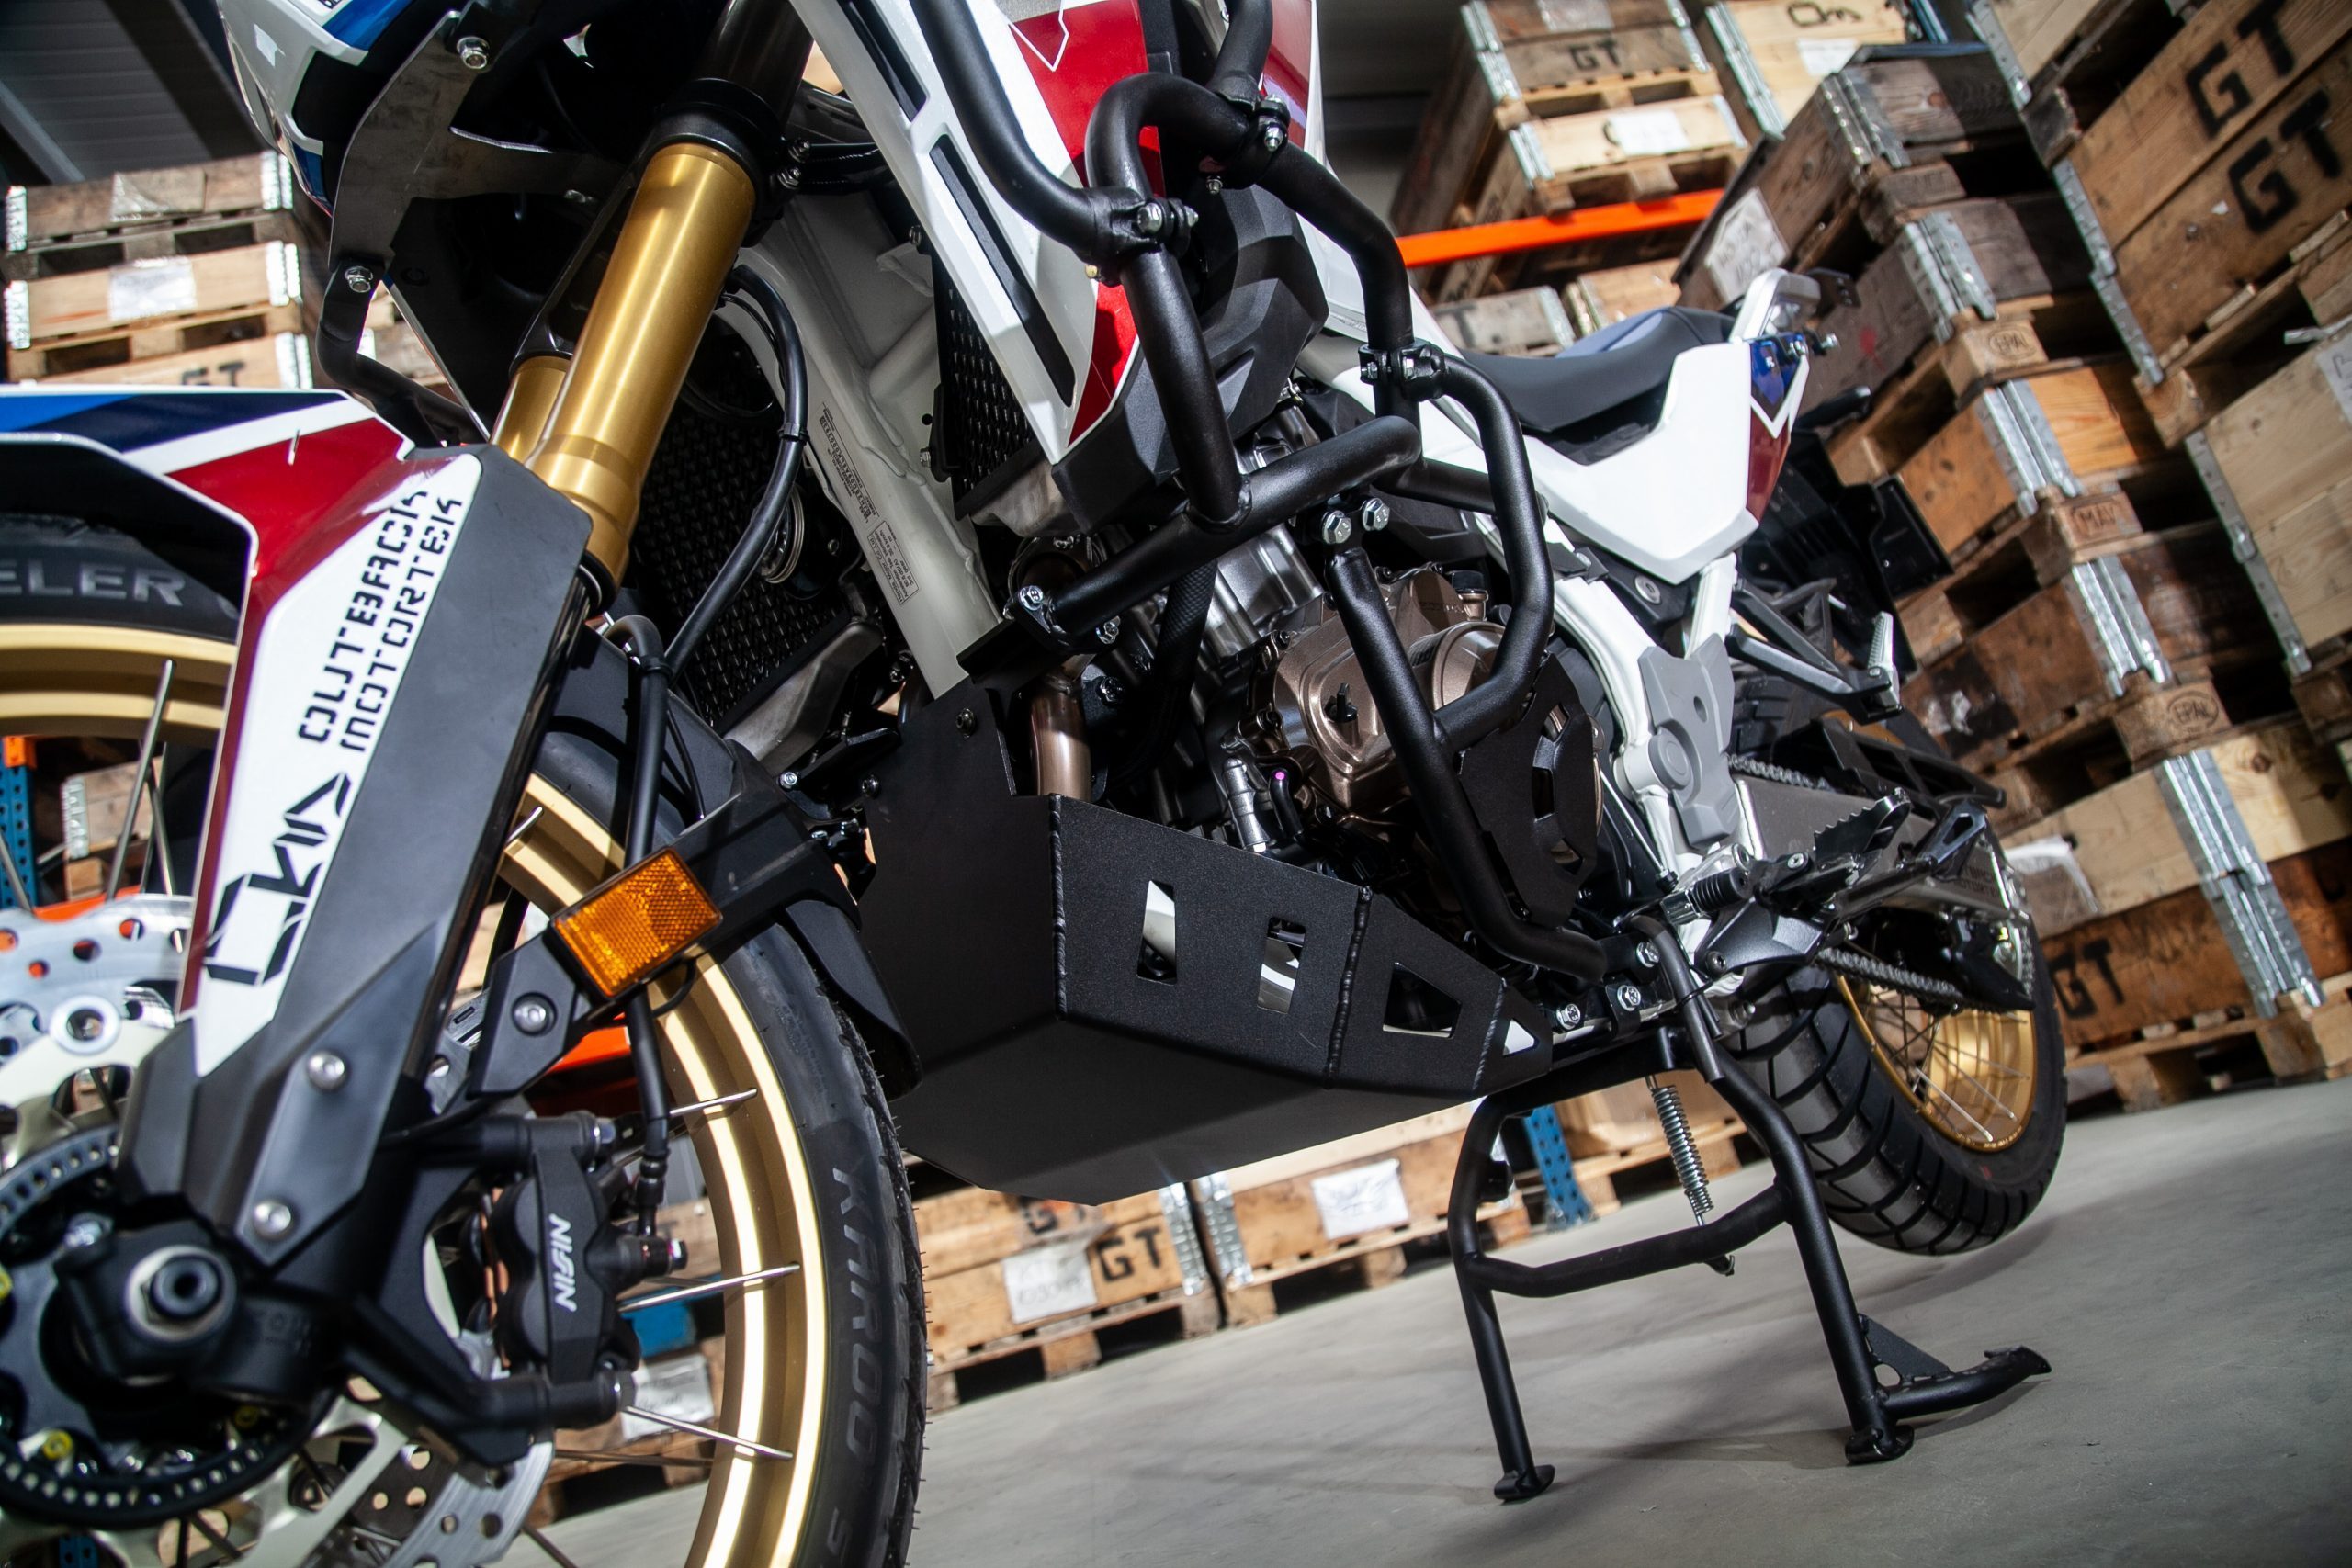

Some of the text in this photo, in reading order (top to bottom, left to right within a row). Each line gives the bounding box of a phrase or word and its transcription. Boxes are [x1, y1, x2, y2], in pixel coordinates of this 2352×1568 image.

[1568, 39, 1621, 72] GT
[2186, 0, 2294, 139] GT
[2229, 89, 2341, 234] GT
[297, 490, 428, 744] OUTBACK
[341, 496, 462, 753] MOTORTEK
[2049, 937, 2125, 1020] GT
[832, 1167, 882, 1459] KAROO
[1096, 1226, 1160, 1282] GT
